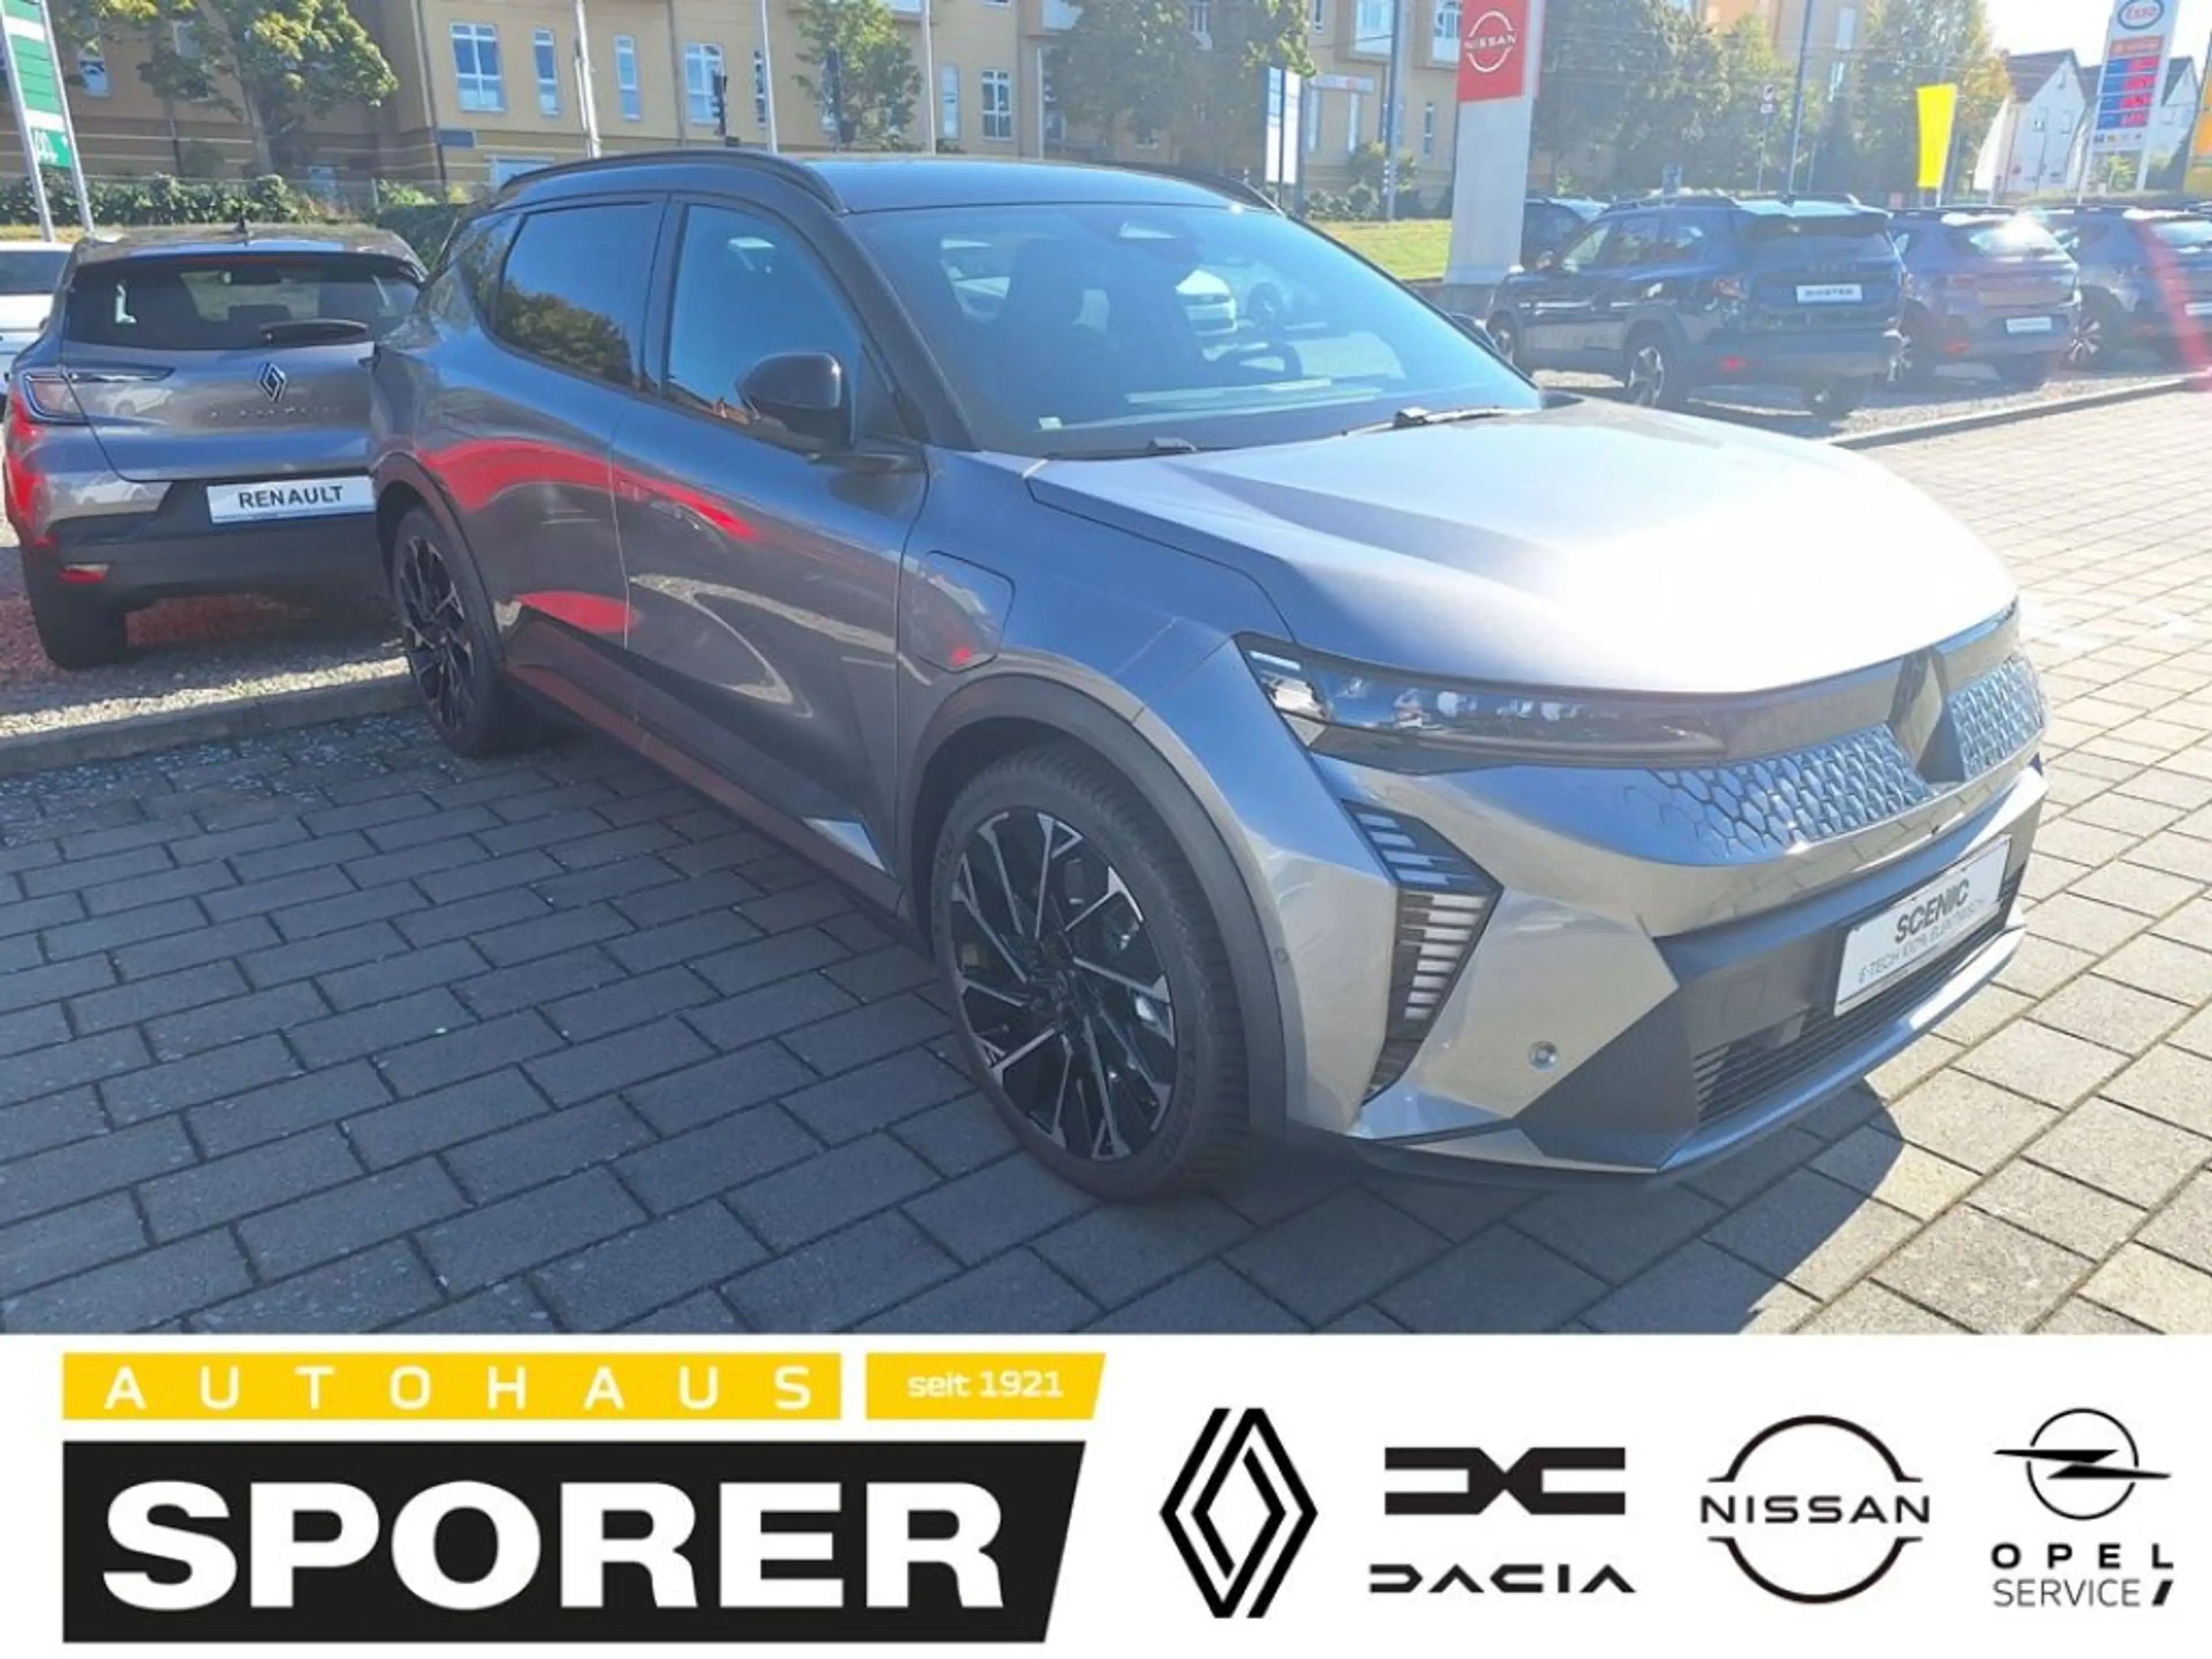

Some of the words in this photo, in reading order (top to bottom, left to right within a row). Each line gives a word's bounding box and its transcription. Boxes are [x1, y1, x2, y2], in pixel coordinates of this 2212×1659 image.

[1464, 32, 1517, 48] NISSAN
[238, 484, 343, 509] RENAULT
[1895, 878, 1969, 944] SCENIC
